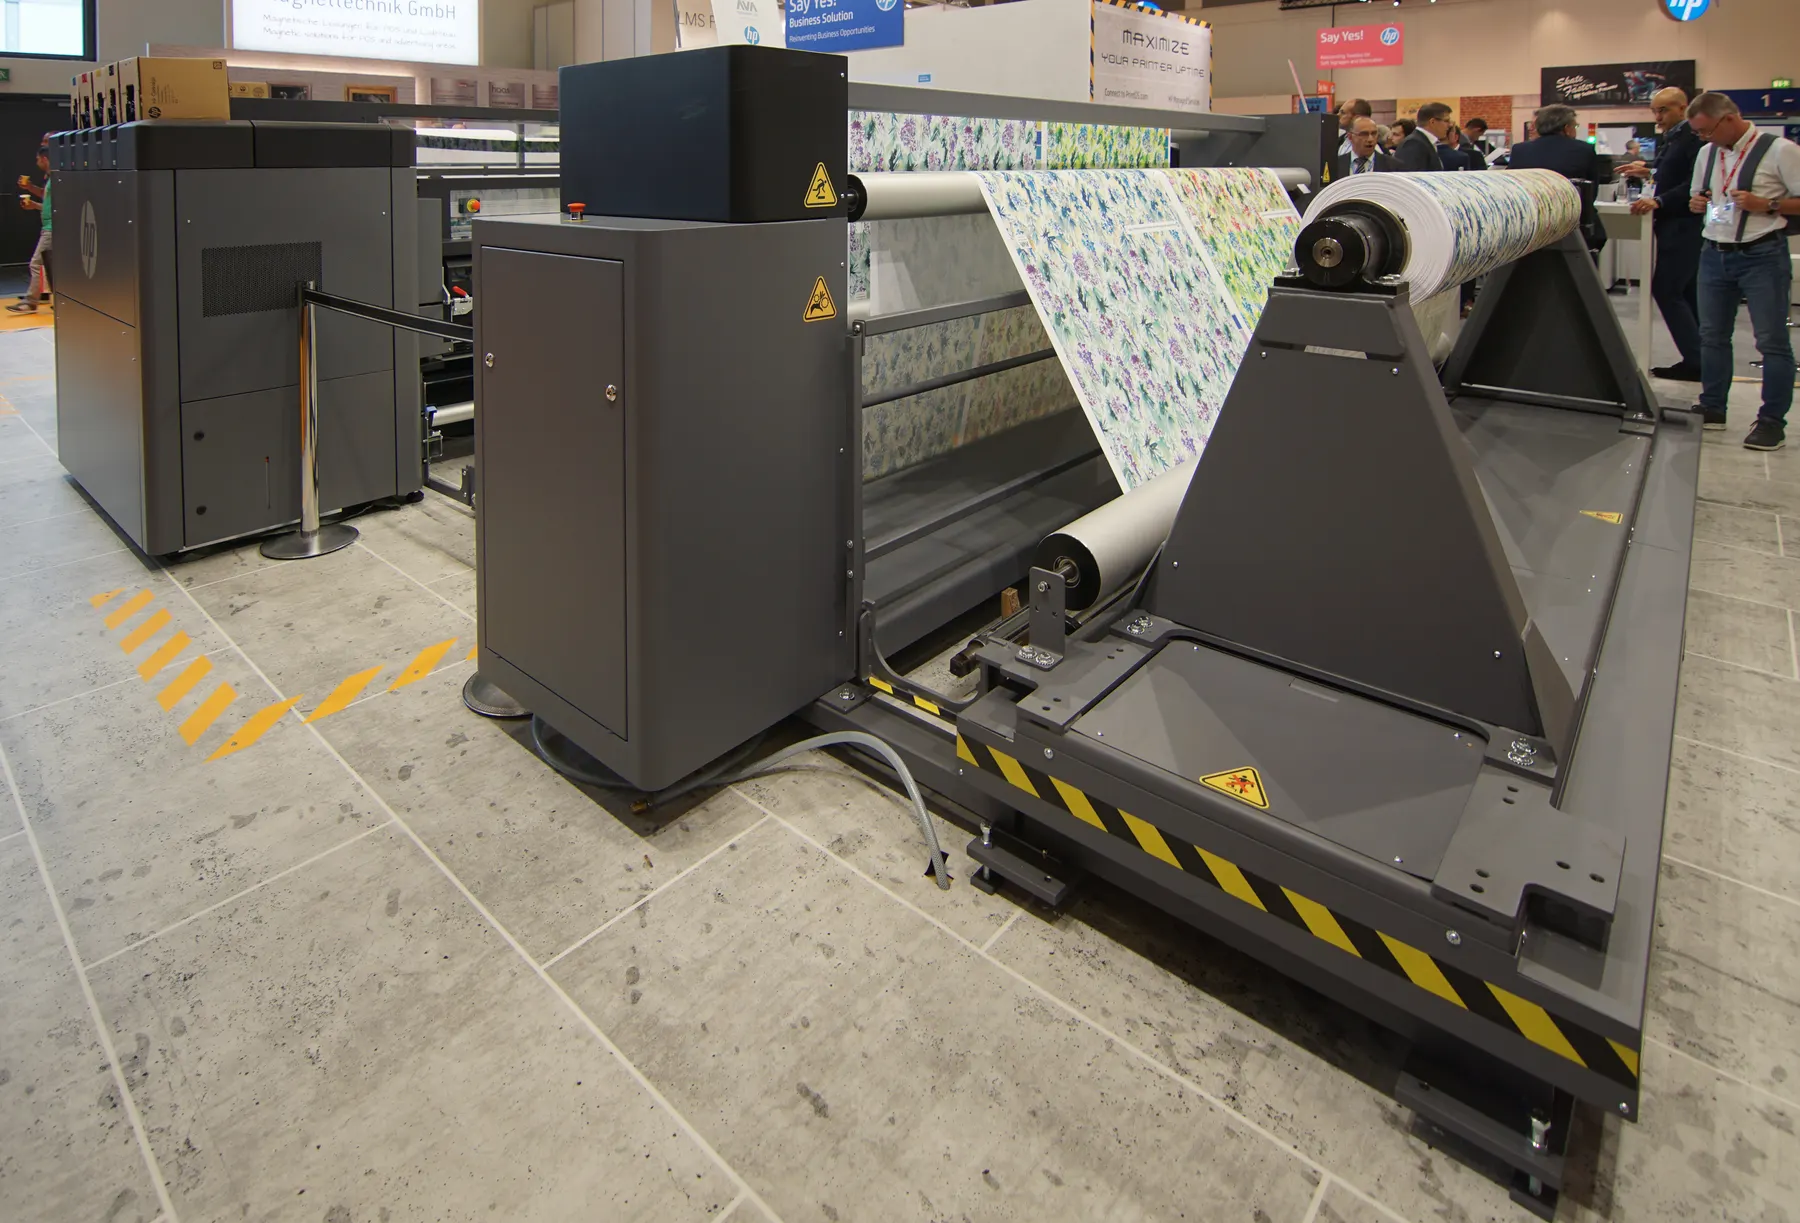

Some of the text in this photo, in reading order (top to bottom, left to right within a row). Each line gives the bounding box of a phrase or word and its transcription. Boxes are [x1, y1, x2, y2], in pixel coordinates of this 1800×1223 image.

[408, 0, 456, 20] GmbH
[789, 0, 810, 14] Say
[789, 11, 854, 28] Business Solution
[744, 26, 760, 46] hp
[789, 25, 876, 43] Reinventing Business Opportunities
[1122, 28, 1190, 56] MAXIMIZE
[1320, 29, 1364, 45] Say Yes!
[1381, 27, 1399, 46] hp
[1101, 52, 1205, 78] YOUR PRINTER UPTIME
[1555, 75, 1584, 89] Skate
[1562, 83, 1595, 98] Faster
[1760, 93, 1771, 108] 1
[81, 200, 97, 280] hp
